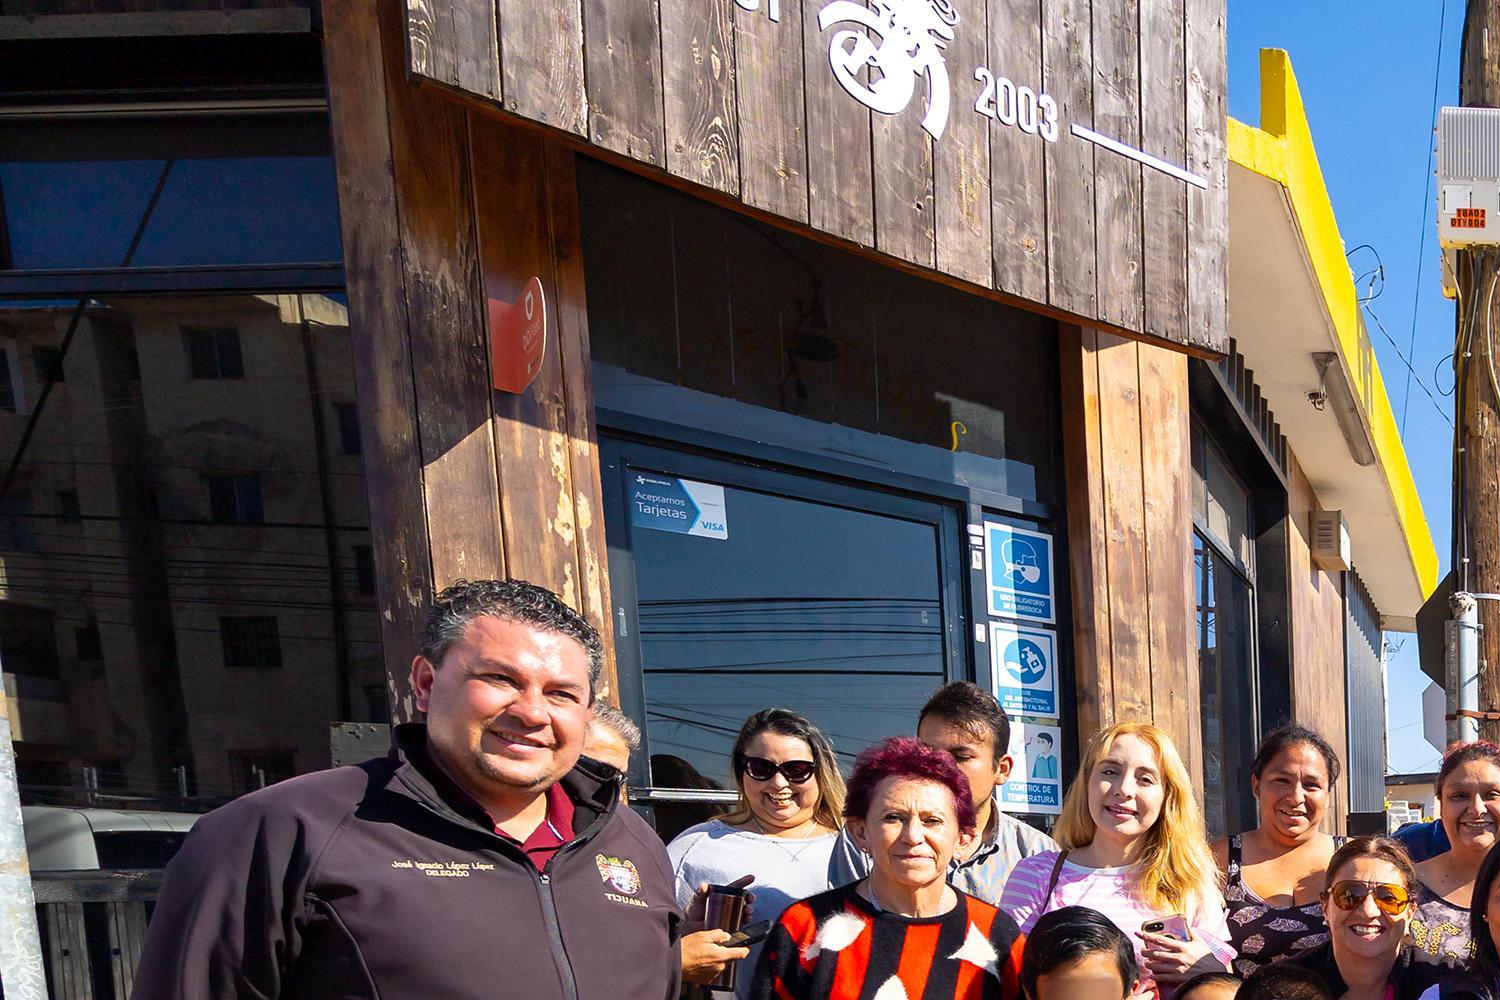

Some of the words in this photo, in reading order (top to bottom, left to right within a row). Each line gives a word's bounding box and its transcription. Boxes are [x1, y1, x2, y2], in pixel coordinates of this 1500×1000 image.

[974, 67, 1058, 143] 2003
[635, 491, 686, 506] Aceptamos
[636, 501, 687, 520] Tarjetas
[701, 521, 725, 532] VISA
[1010, 783, 1041, 792] CONTROL
[1042, 785, 1051, 793] DE
[1008, 793, 1055, 803] TEMPERATURA
[392, 860, 413, 868] José
[415, 861, 444, 871] Ignacio
[446, 861, 470, 870] López
[604, 893, 648, 908] TIJUANA
